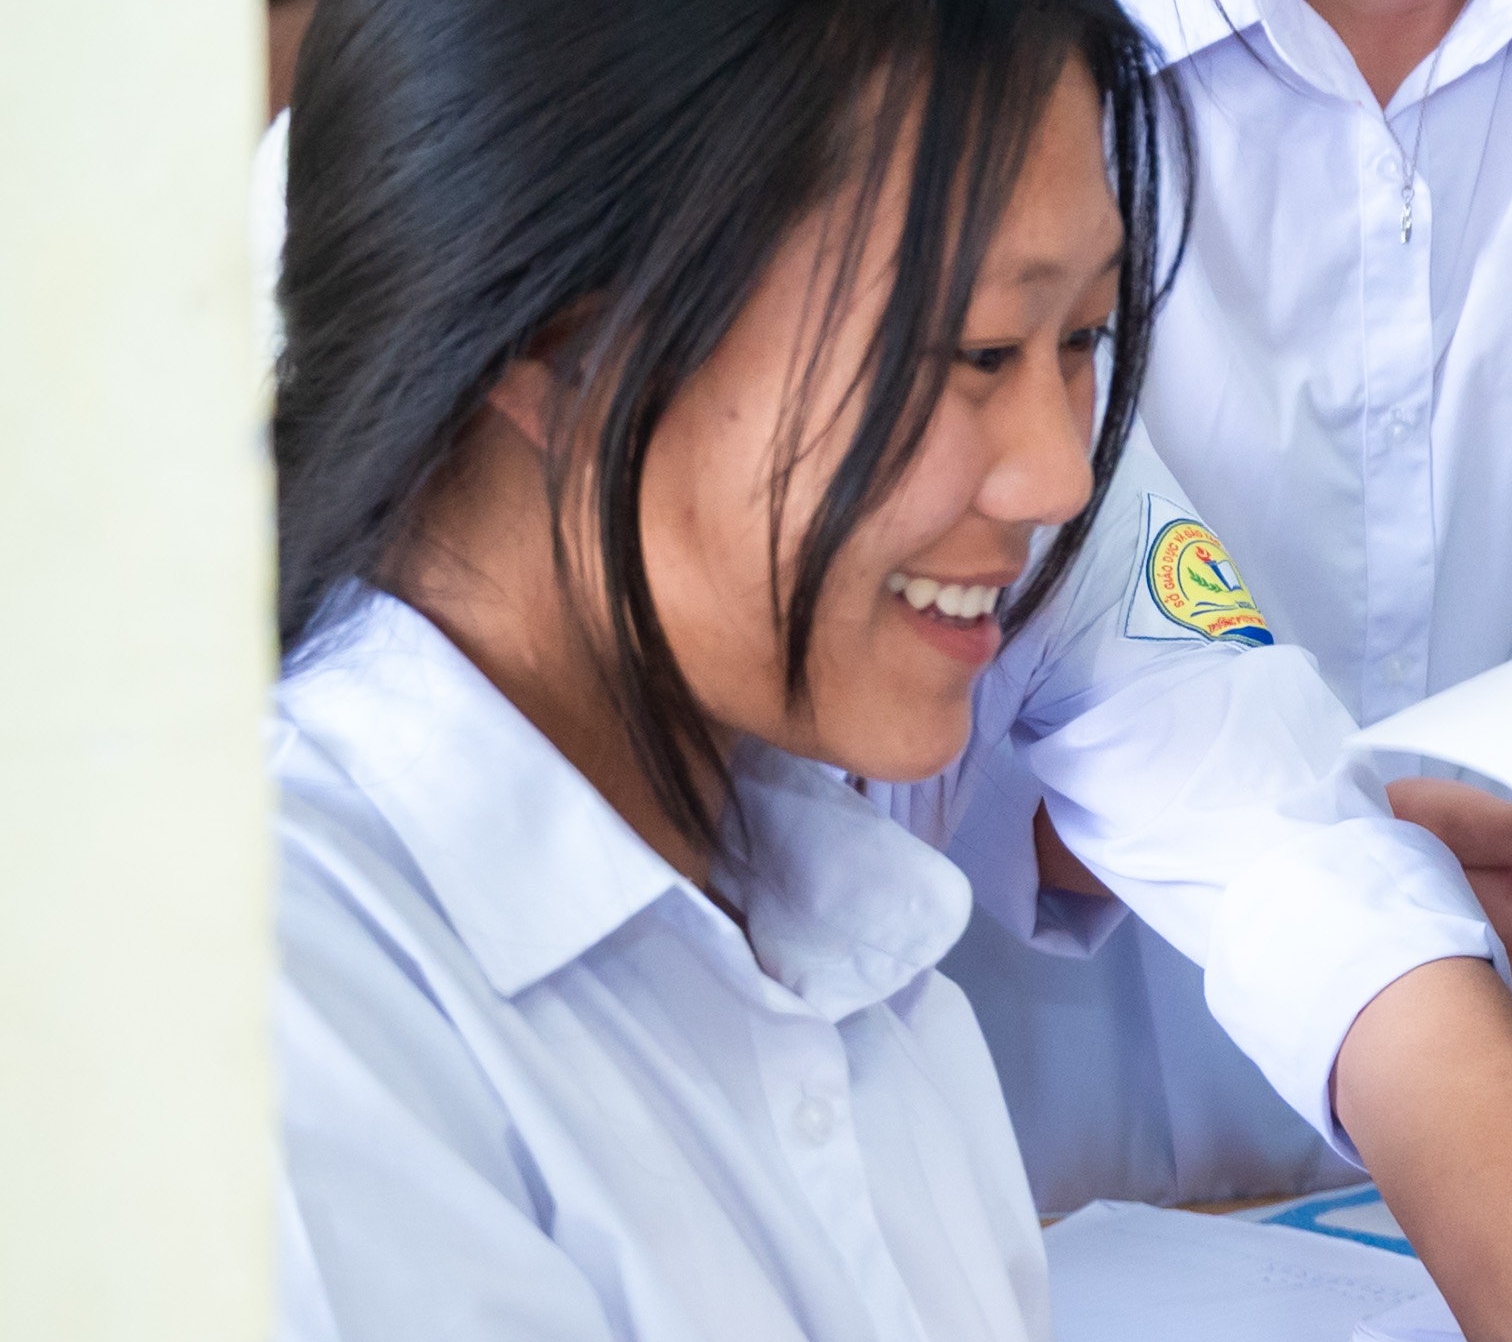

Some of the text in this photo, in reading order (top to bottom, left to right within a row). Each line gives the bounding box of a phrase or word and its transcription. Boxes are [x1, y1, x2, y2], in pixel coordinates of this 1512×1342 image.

[1174, 530, 1185, 543] VÀ
[1163, 542, 1179, 563] DỤC
[1157, 565, 1175, 590] GIÁO
